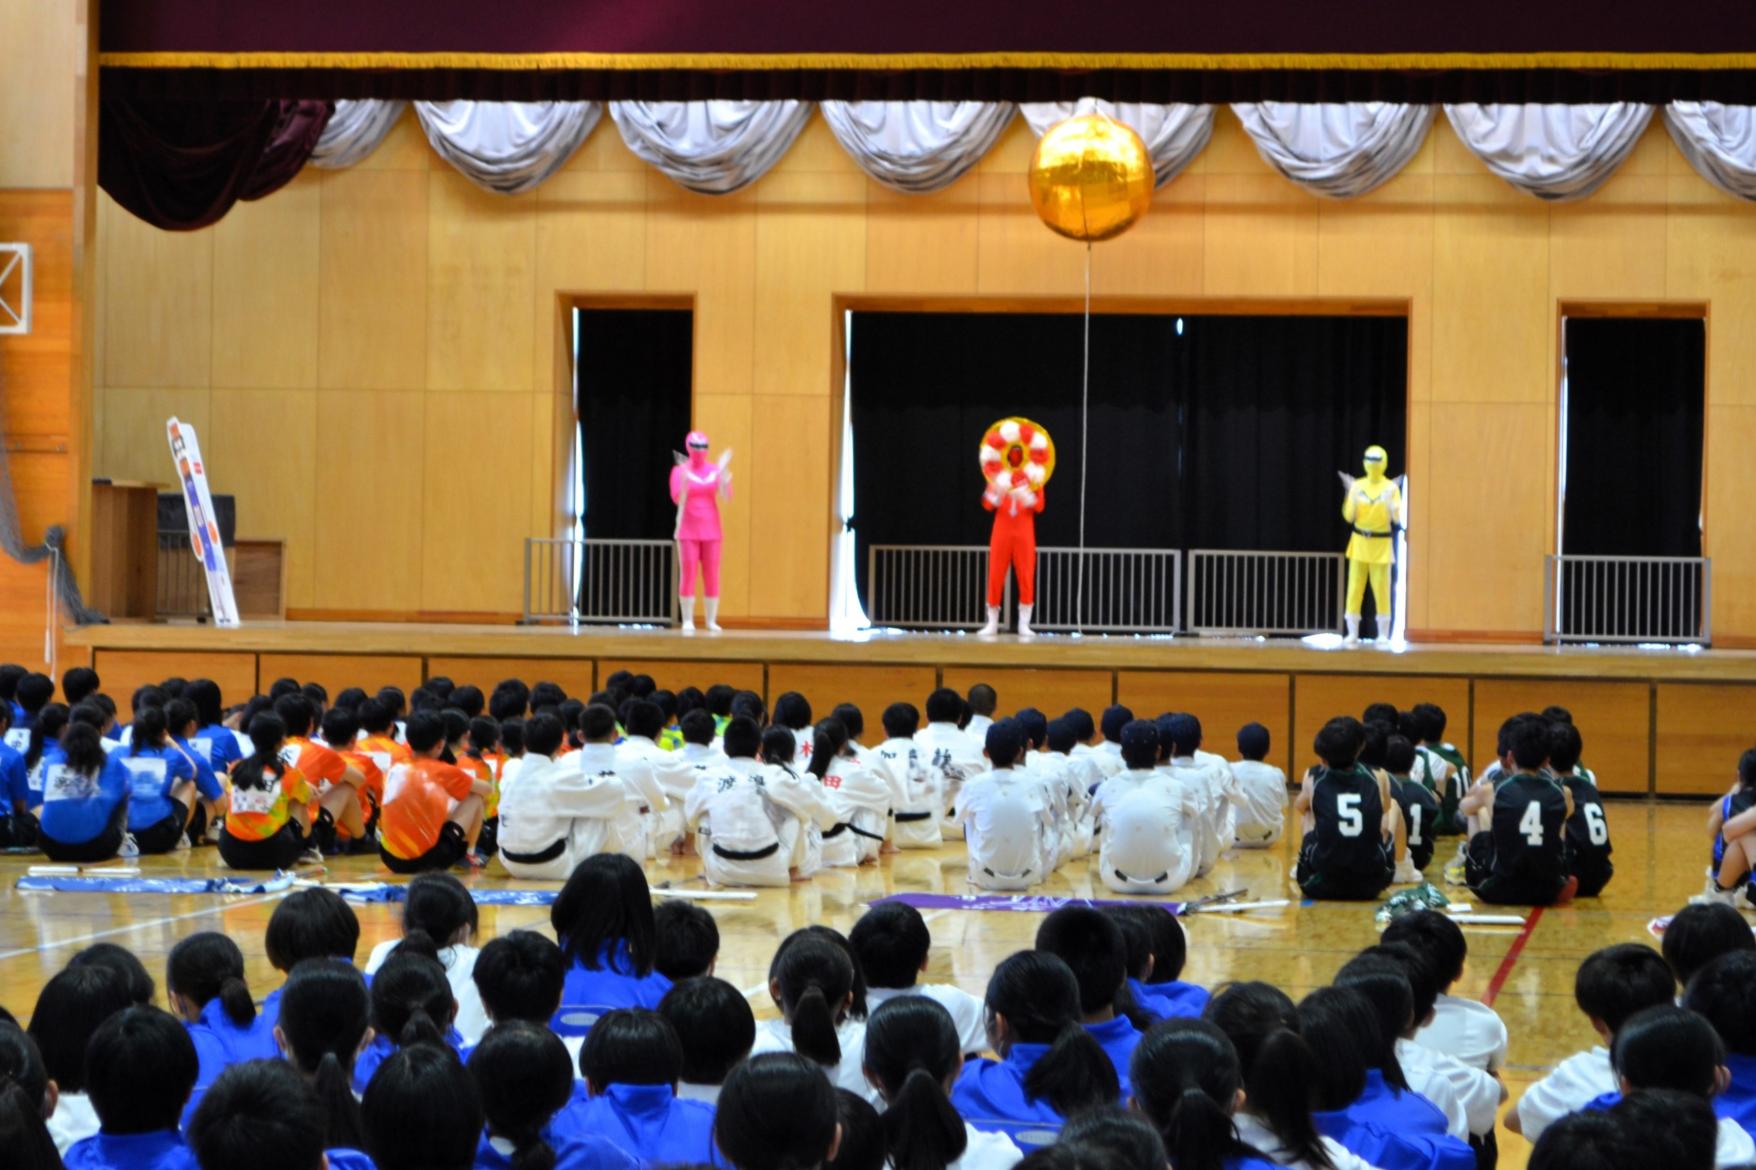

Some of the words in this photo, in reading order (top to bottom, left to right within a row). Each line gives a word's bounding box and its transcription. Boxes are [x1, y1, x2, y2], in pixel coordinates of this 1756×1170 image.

[1337, 793, 1363, 837] 5
[1519, 800, 1544, 846] 4
[1583, 802, 1608, 846] 6
